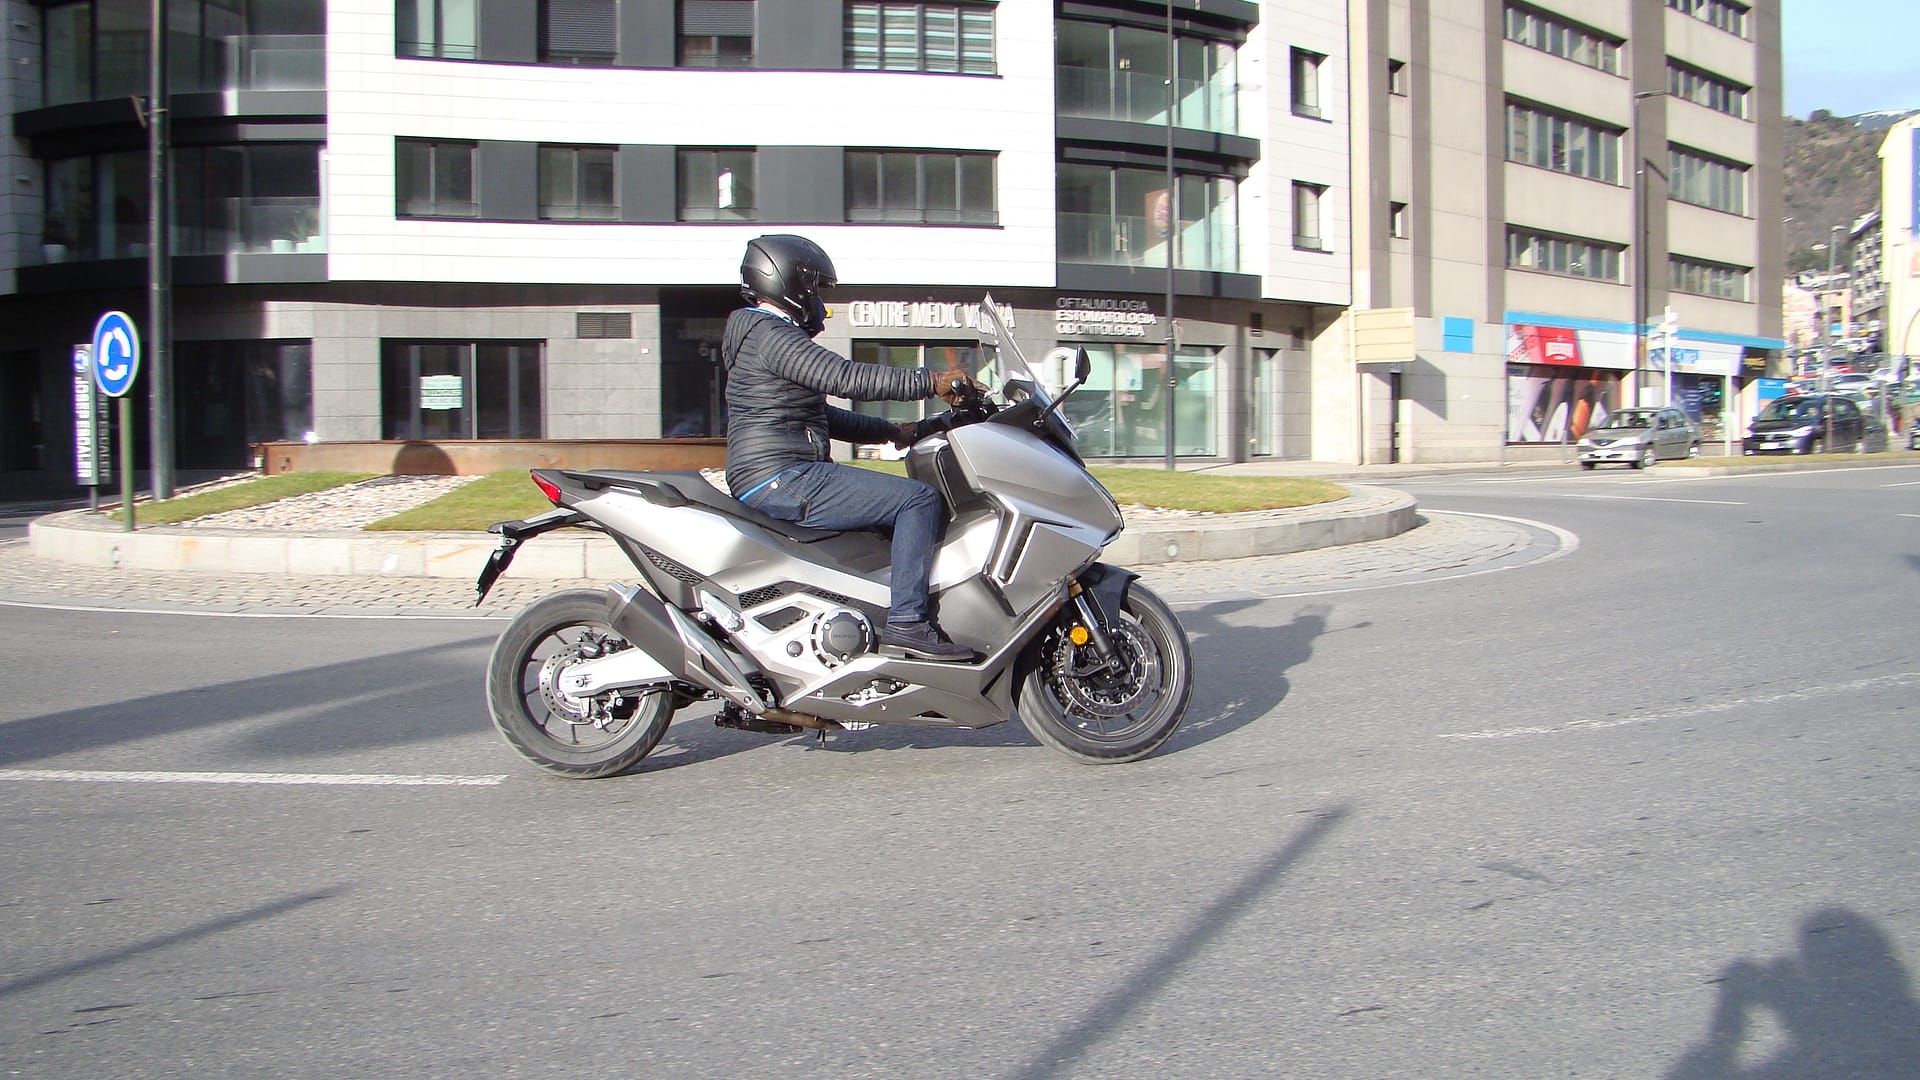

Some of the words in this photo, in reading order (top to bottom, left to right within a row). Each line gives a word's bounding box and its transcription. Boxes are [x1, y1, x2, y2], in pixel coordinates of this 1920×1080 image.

[1056, 297, 1149, 311] OFTALMOLOGIA
[848, 301, 910, 328] CENTRE
[1056, 310, 1157, 325] ESTOMATOLOGIA
[1056, 322, 1145, 337] ODONTOLOGIA
